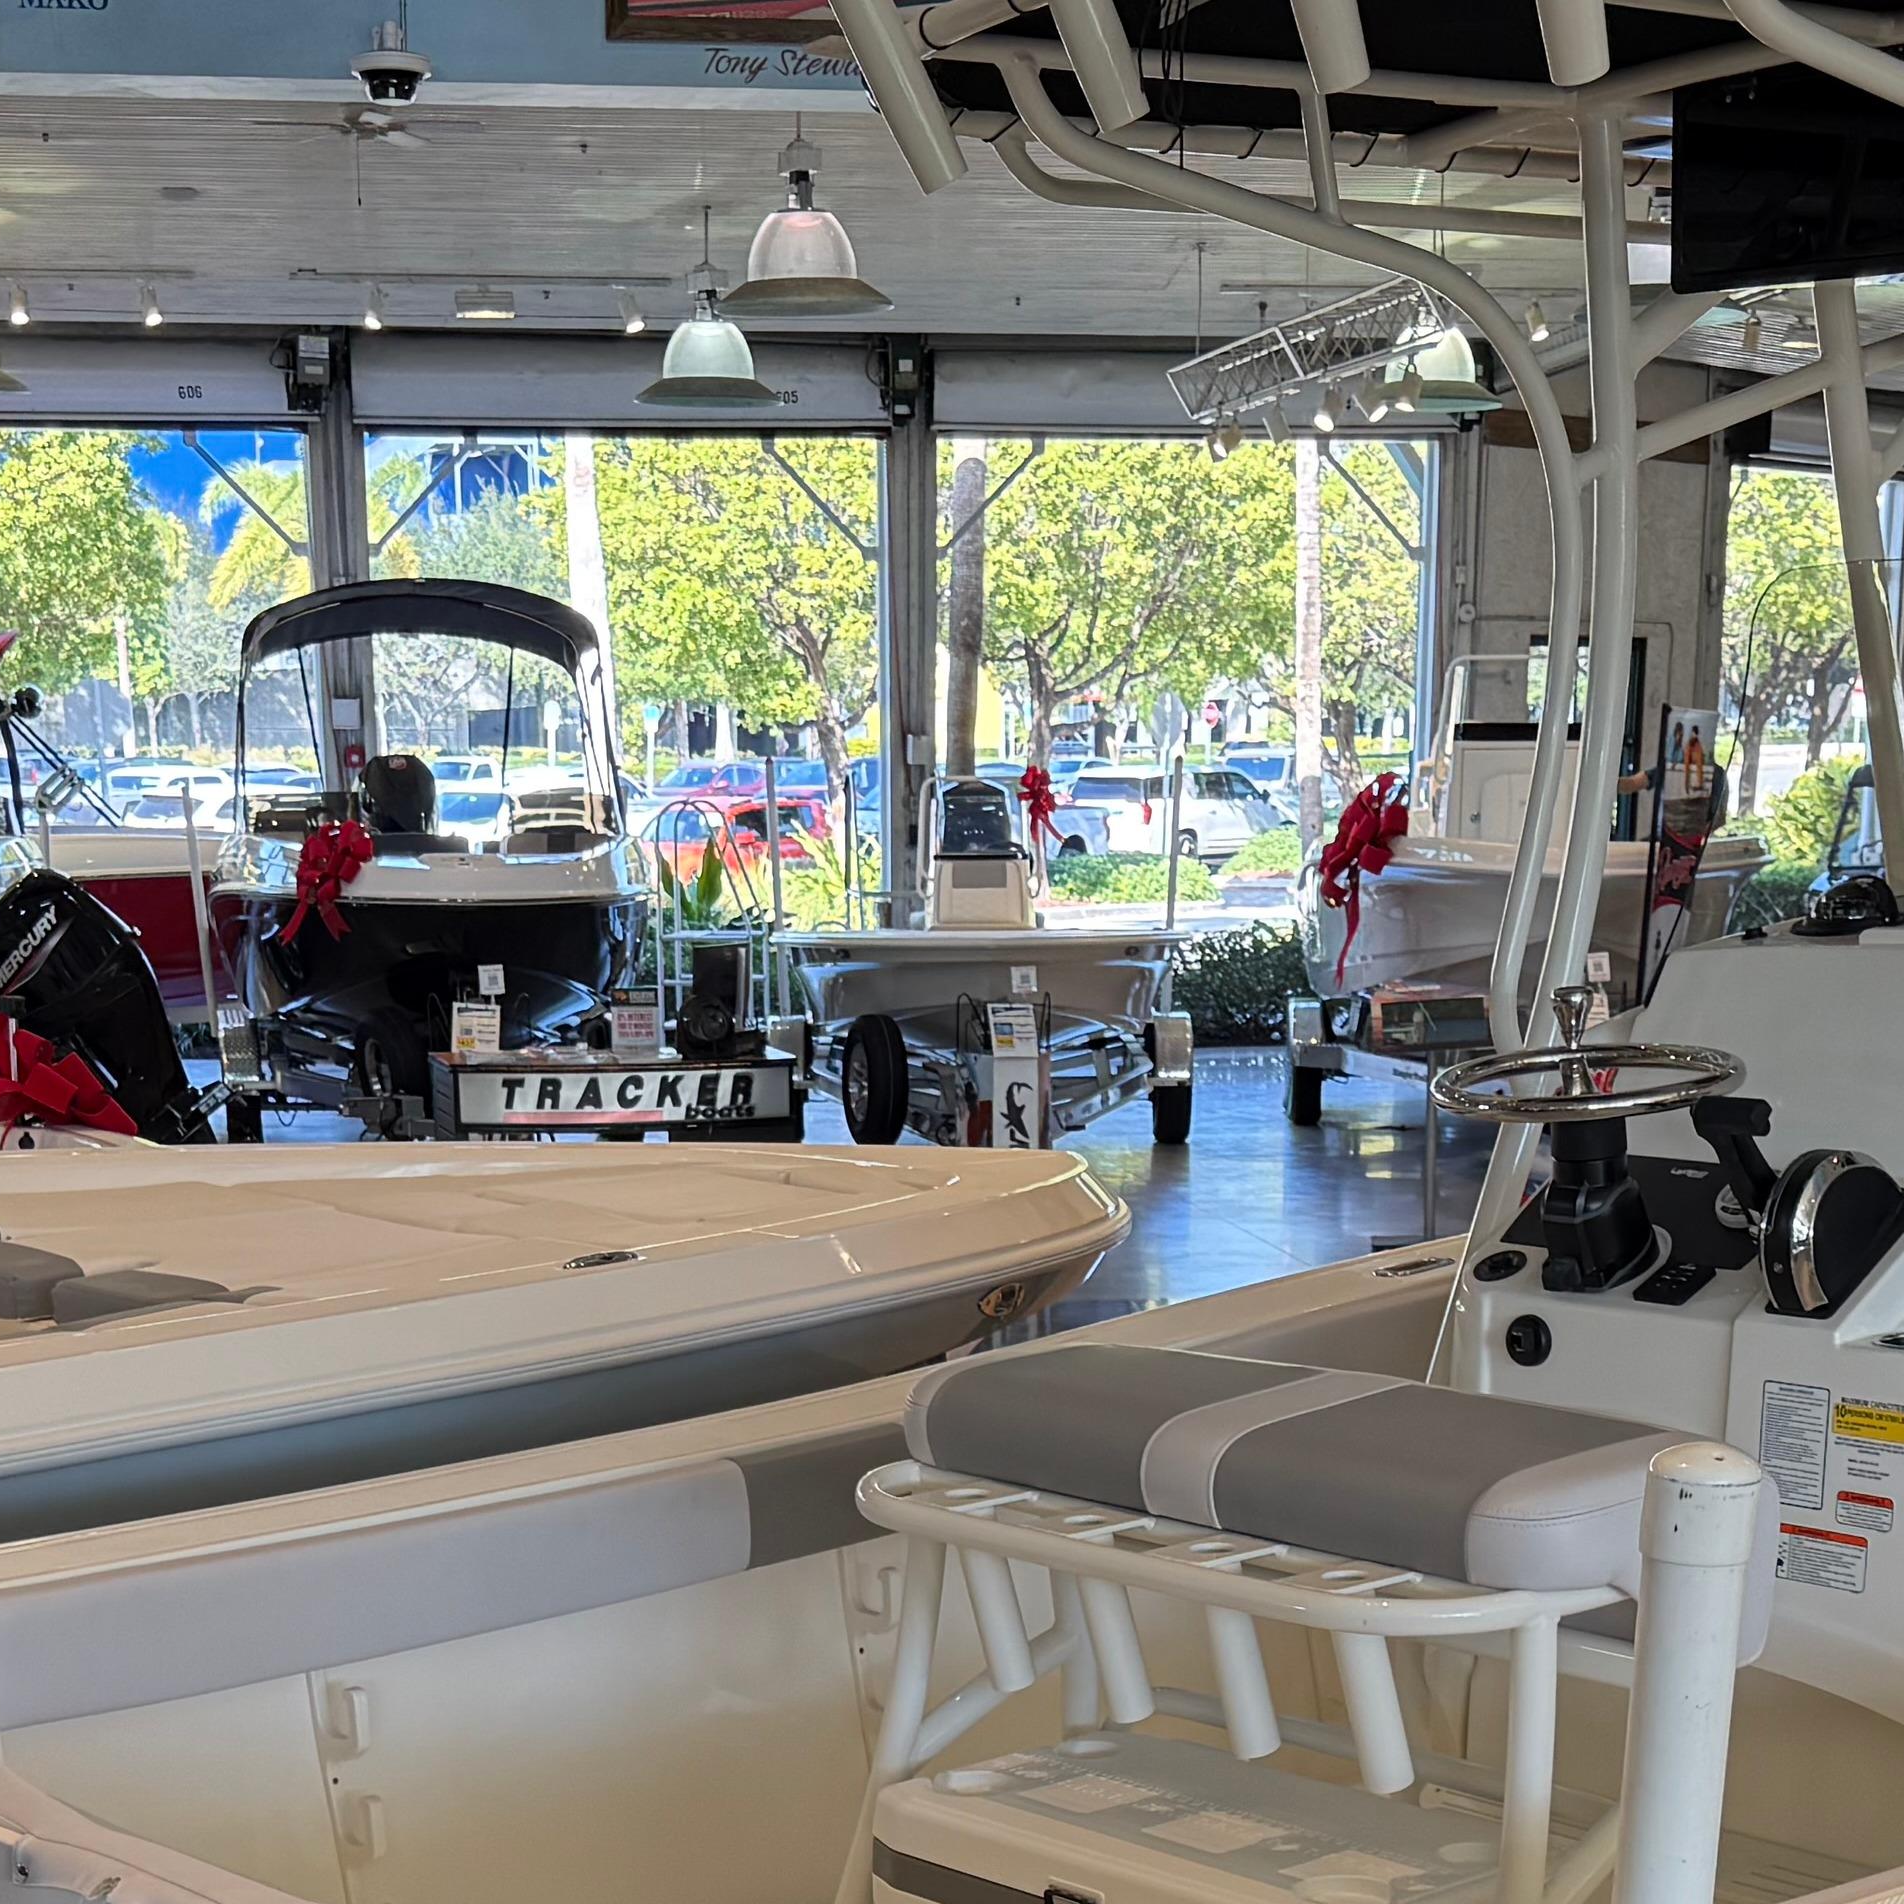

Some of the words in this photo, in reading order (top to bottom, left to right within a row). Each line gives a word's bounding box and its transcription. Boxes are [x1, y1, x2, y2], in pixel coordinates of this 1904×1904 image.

[704, 48, 767, 83] Tony
[773, 50, 863, 77] Stewa
[178, 385, 202, 399] 606
[501, 1072, 755, 1110] TRACKER
[685, 1102, 756, 1120] boats
